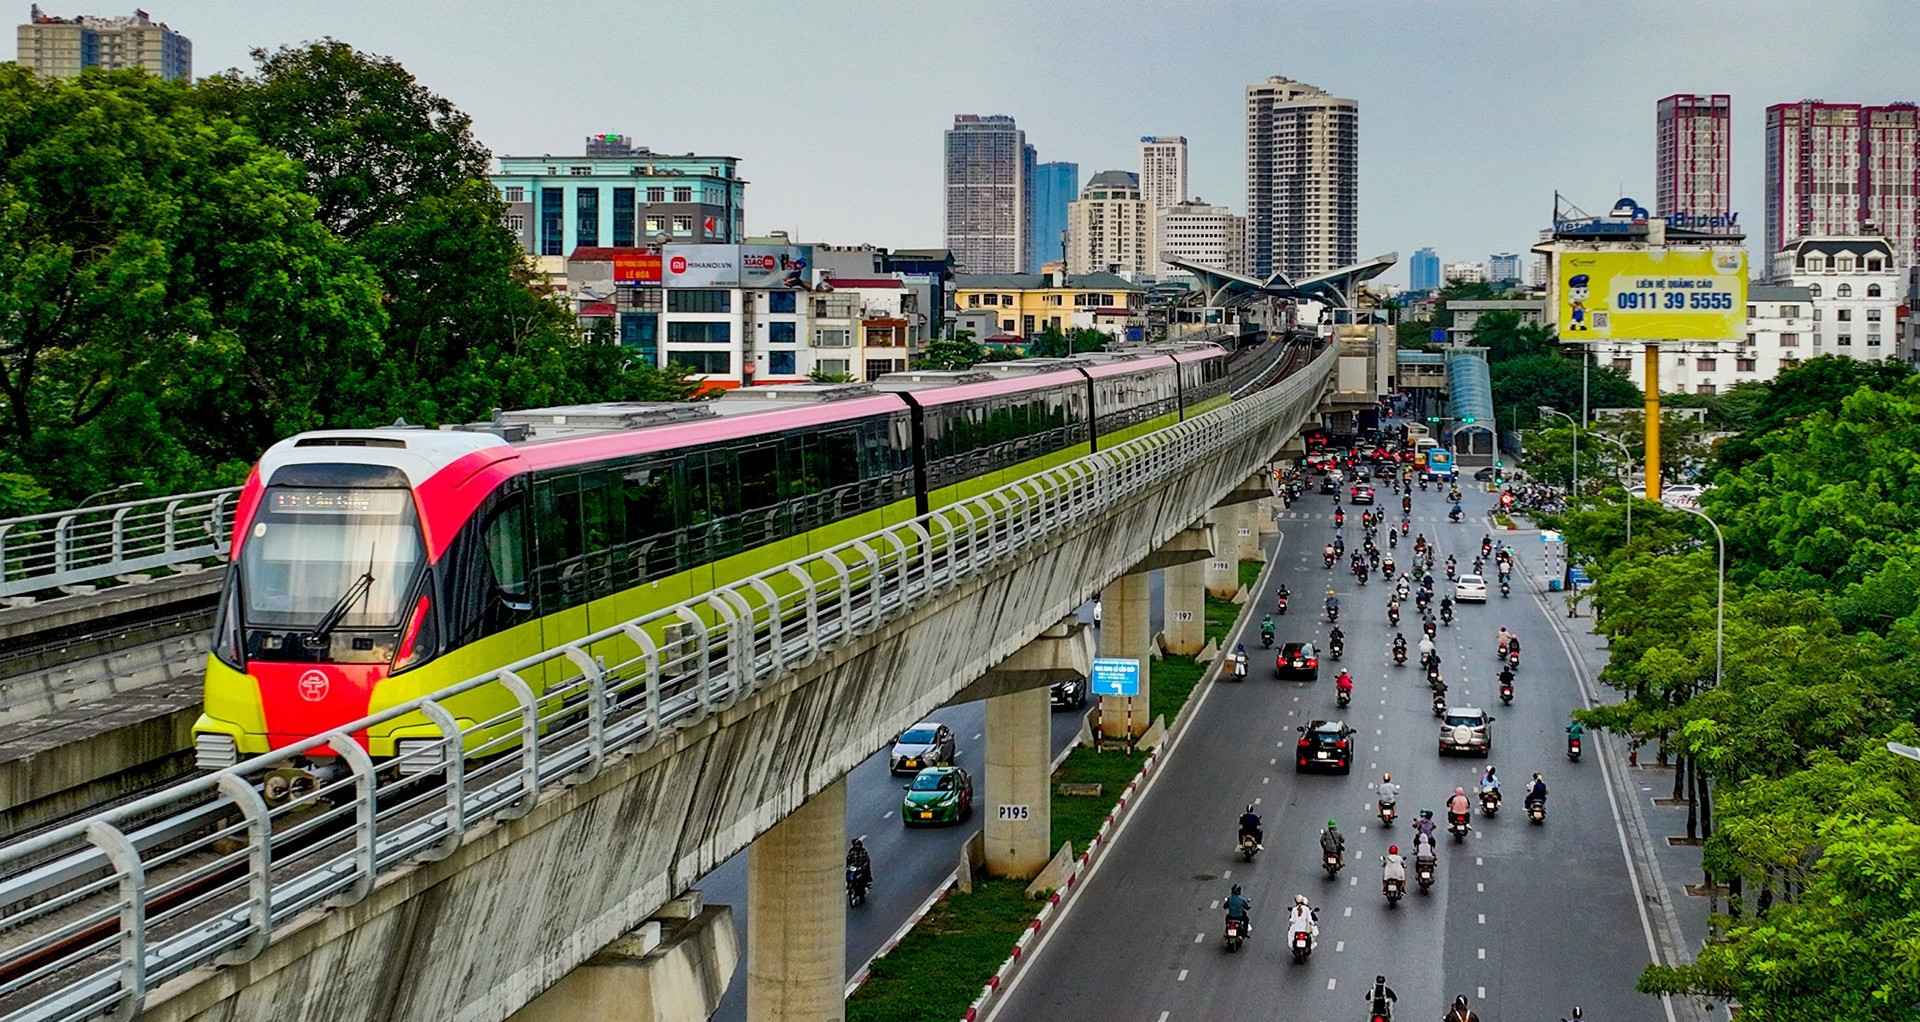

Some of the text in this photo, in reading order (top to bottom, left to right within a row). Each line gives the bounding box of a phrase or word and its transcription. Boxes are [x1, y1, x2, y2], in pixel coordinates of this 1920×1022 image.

[1636, 277, 1713, 290] LIÊN HỆ QUẢNG CÁO
[1618, 292, 1732, 309] 0911 39 5555
[999, 806, 1028, 819] P195
